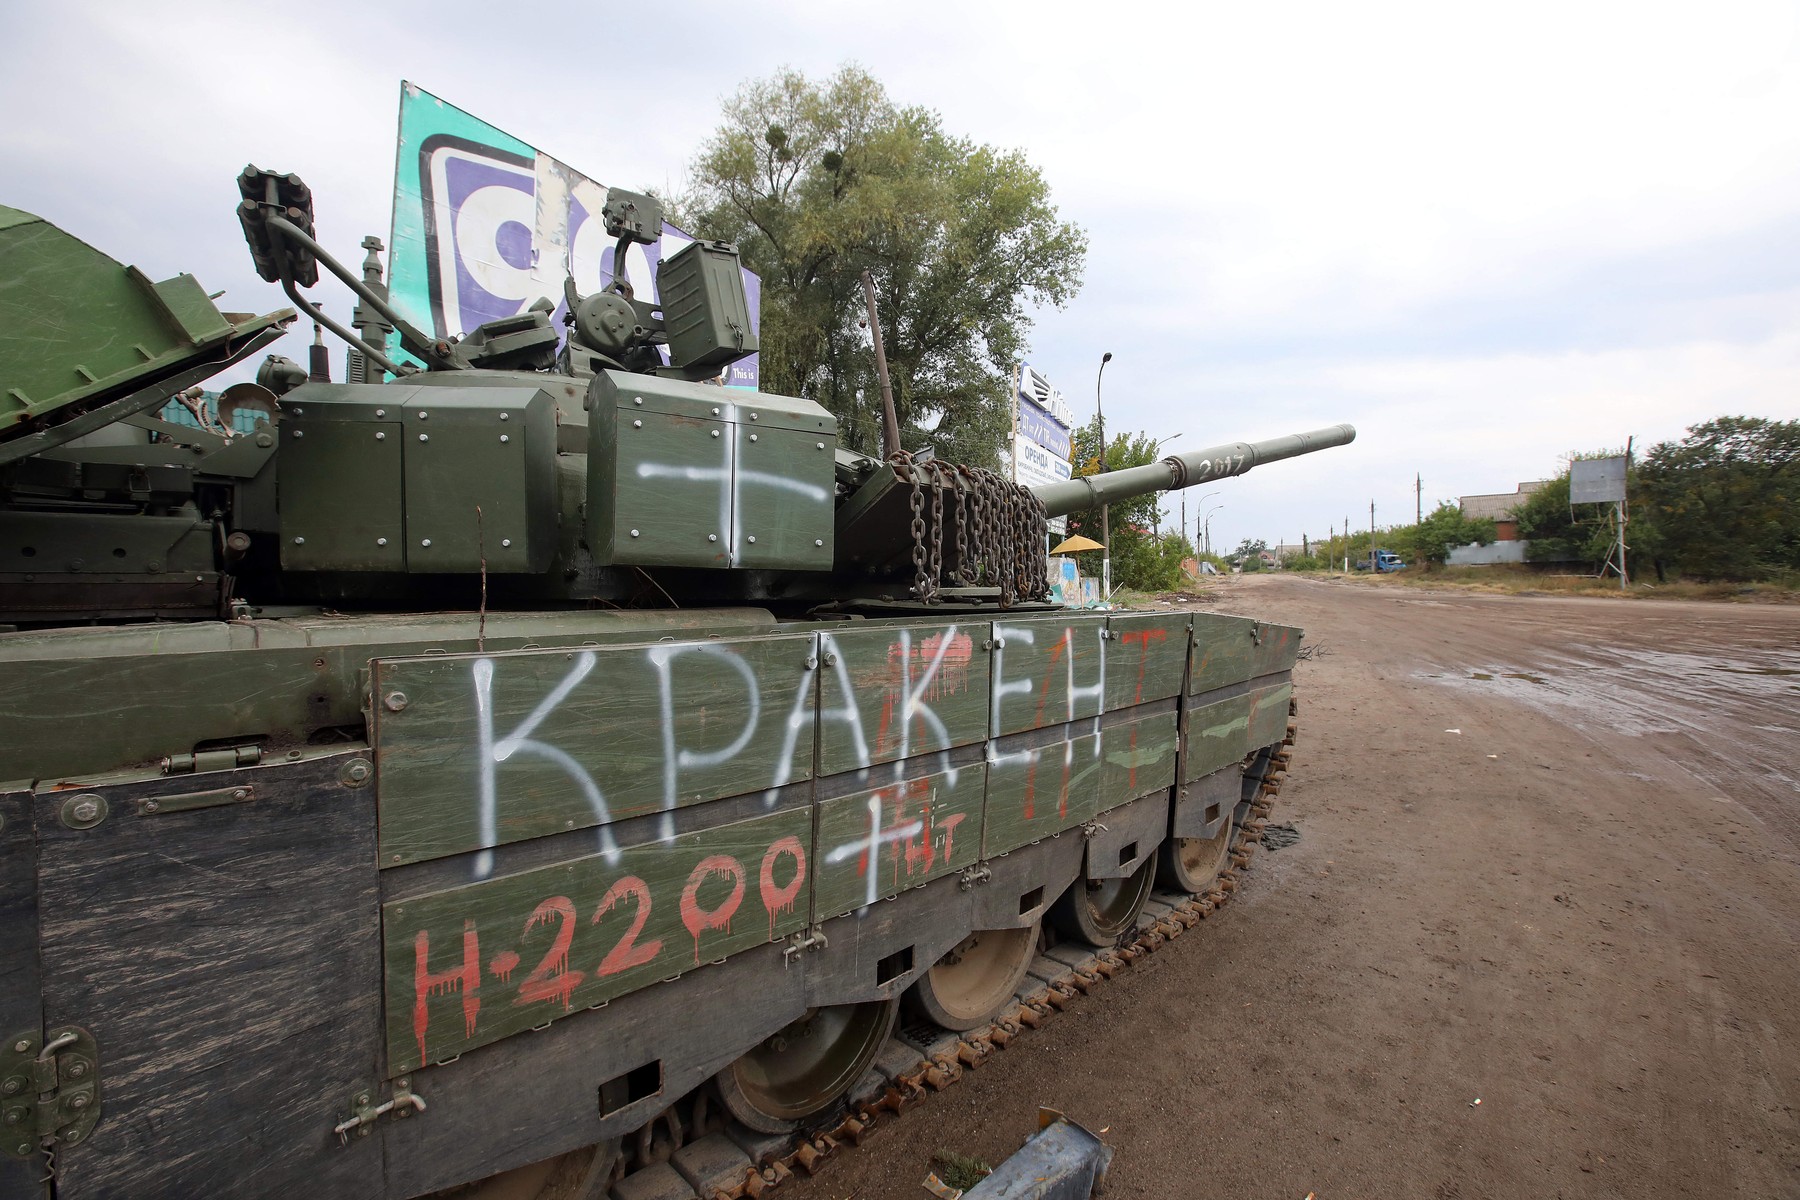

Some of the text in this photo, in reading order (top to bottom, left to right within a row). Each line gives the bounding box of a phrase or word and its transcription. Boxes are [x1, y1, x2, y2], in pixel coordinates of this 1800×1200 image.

[733, 368, 754, 379] This is
[1024, 445, 1048, 470] ОРЕНДА
[1199, 454, 1245, 481] 2017
[472, 622, 1106, 880] КРАКЕН
